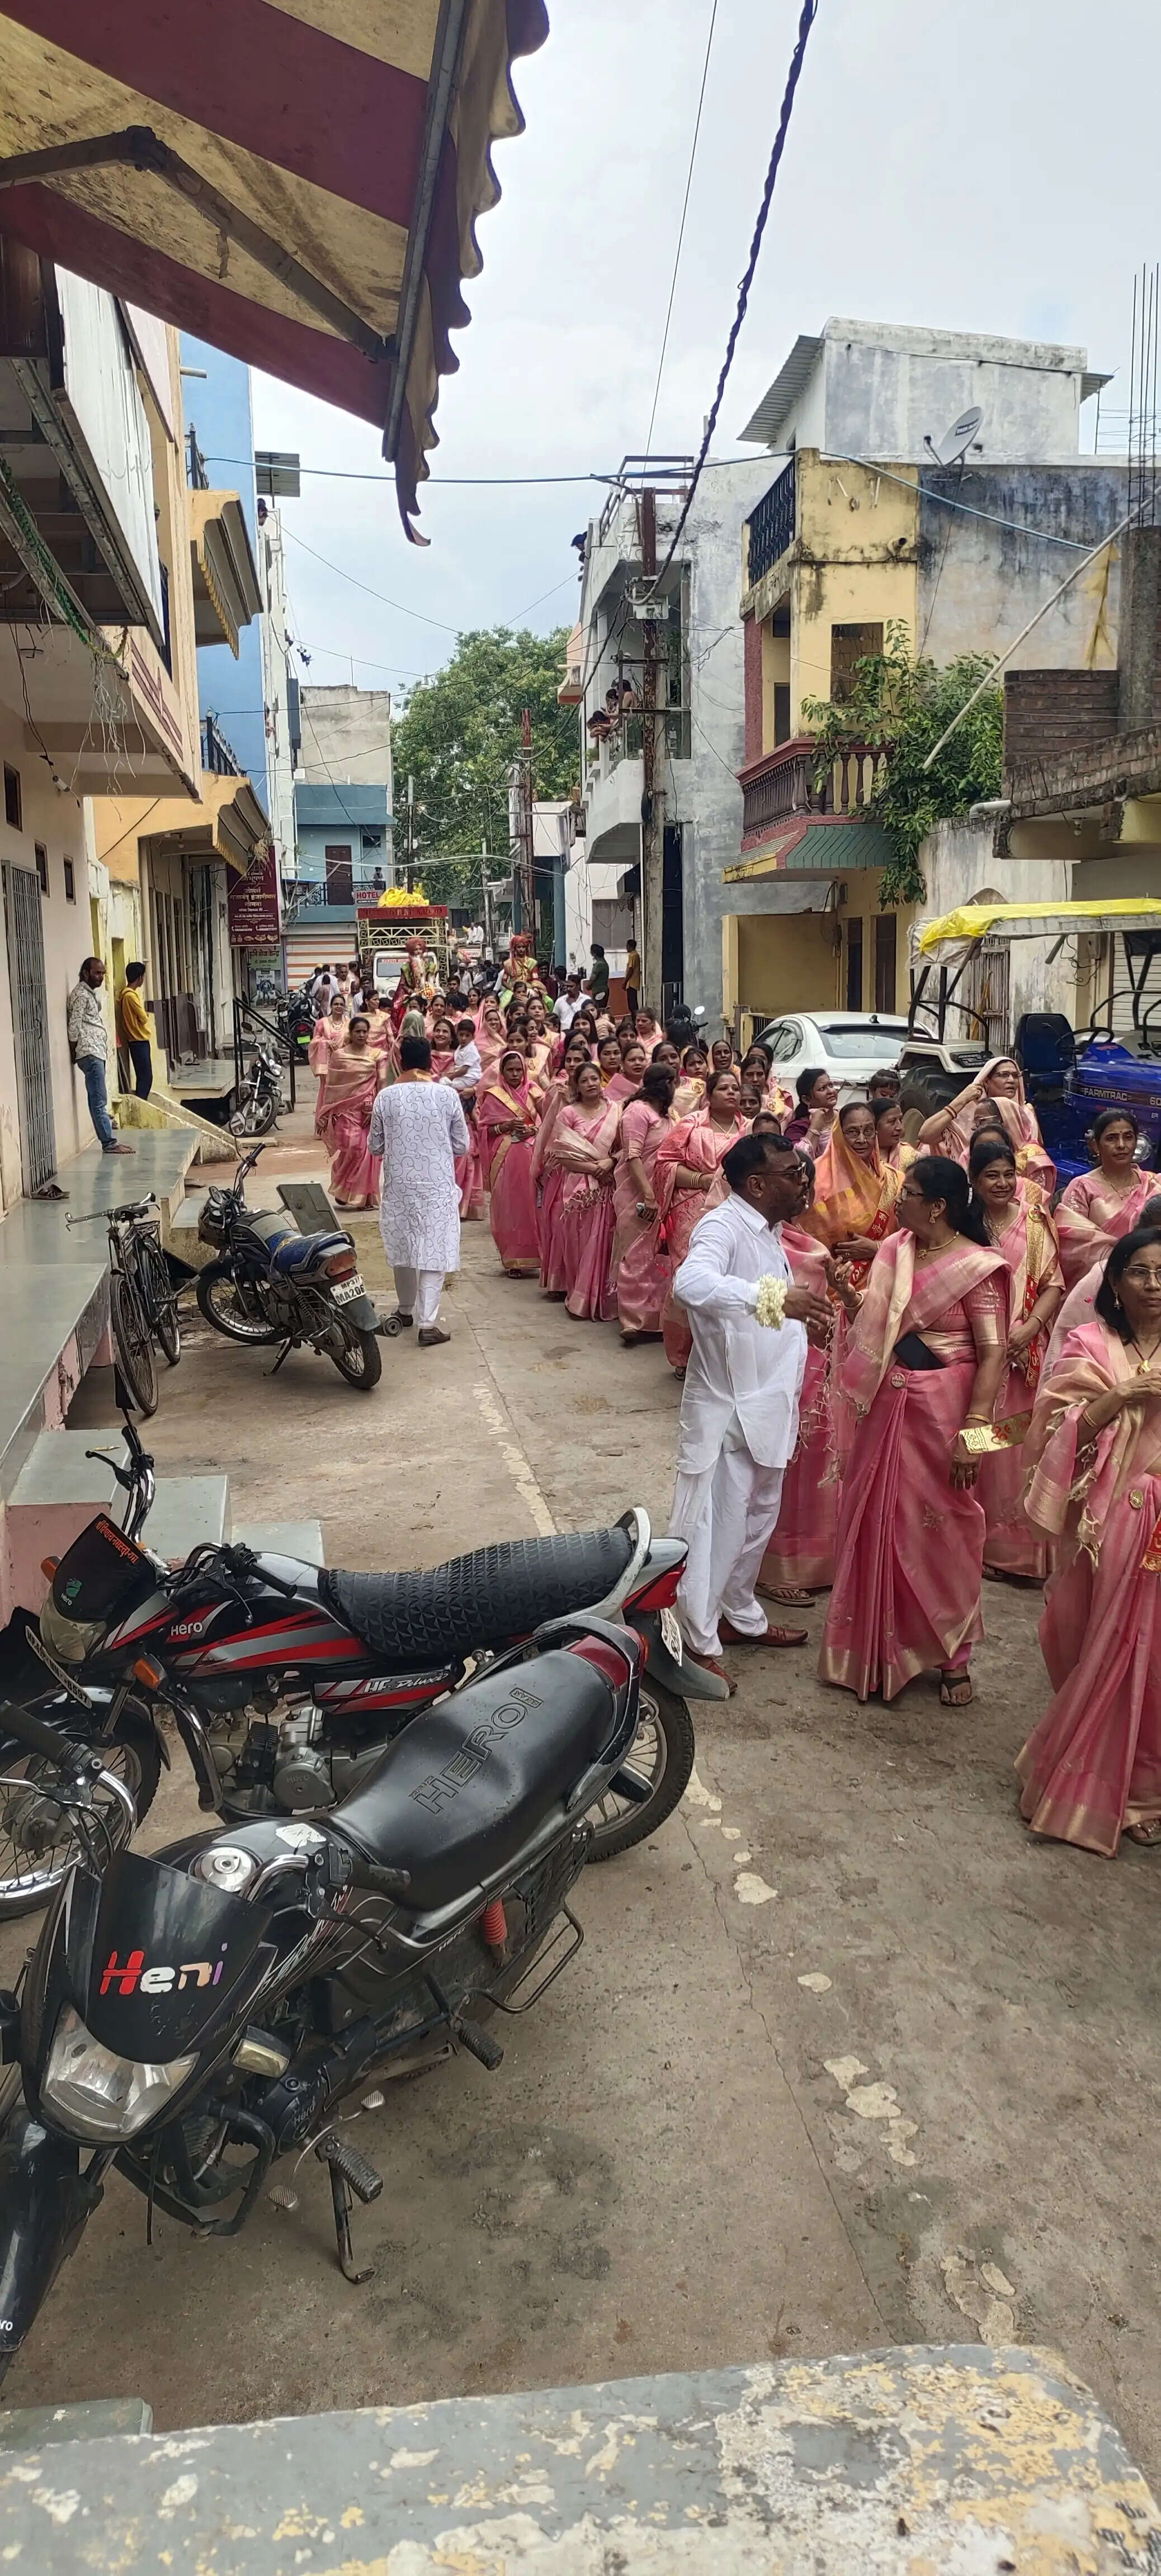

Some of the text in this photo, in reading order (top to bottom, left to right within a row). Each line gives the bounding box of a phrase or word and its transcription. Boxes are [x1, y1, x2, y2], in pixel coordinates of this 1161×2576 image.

[1084, 1087, 1127, 1101] FARMTRAC
[60, 1593, 72, 1606] Hero
[171, 1622, 203, 1636] Hero
[100, 1943, 228, 1995] Heni
[0, 2319, 13, 2331] ro
